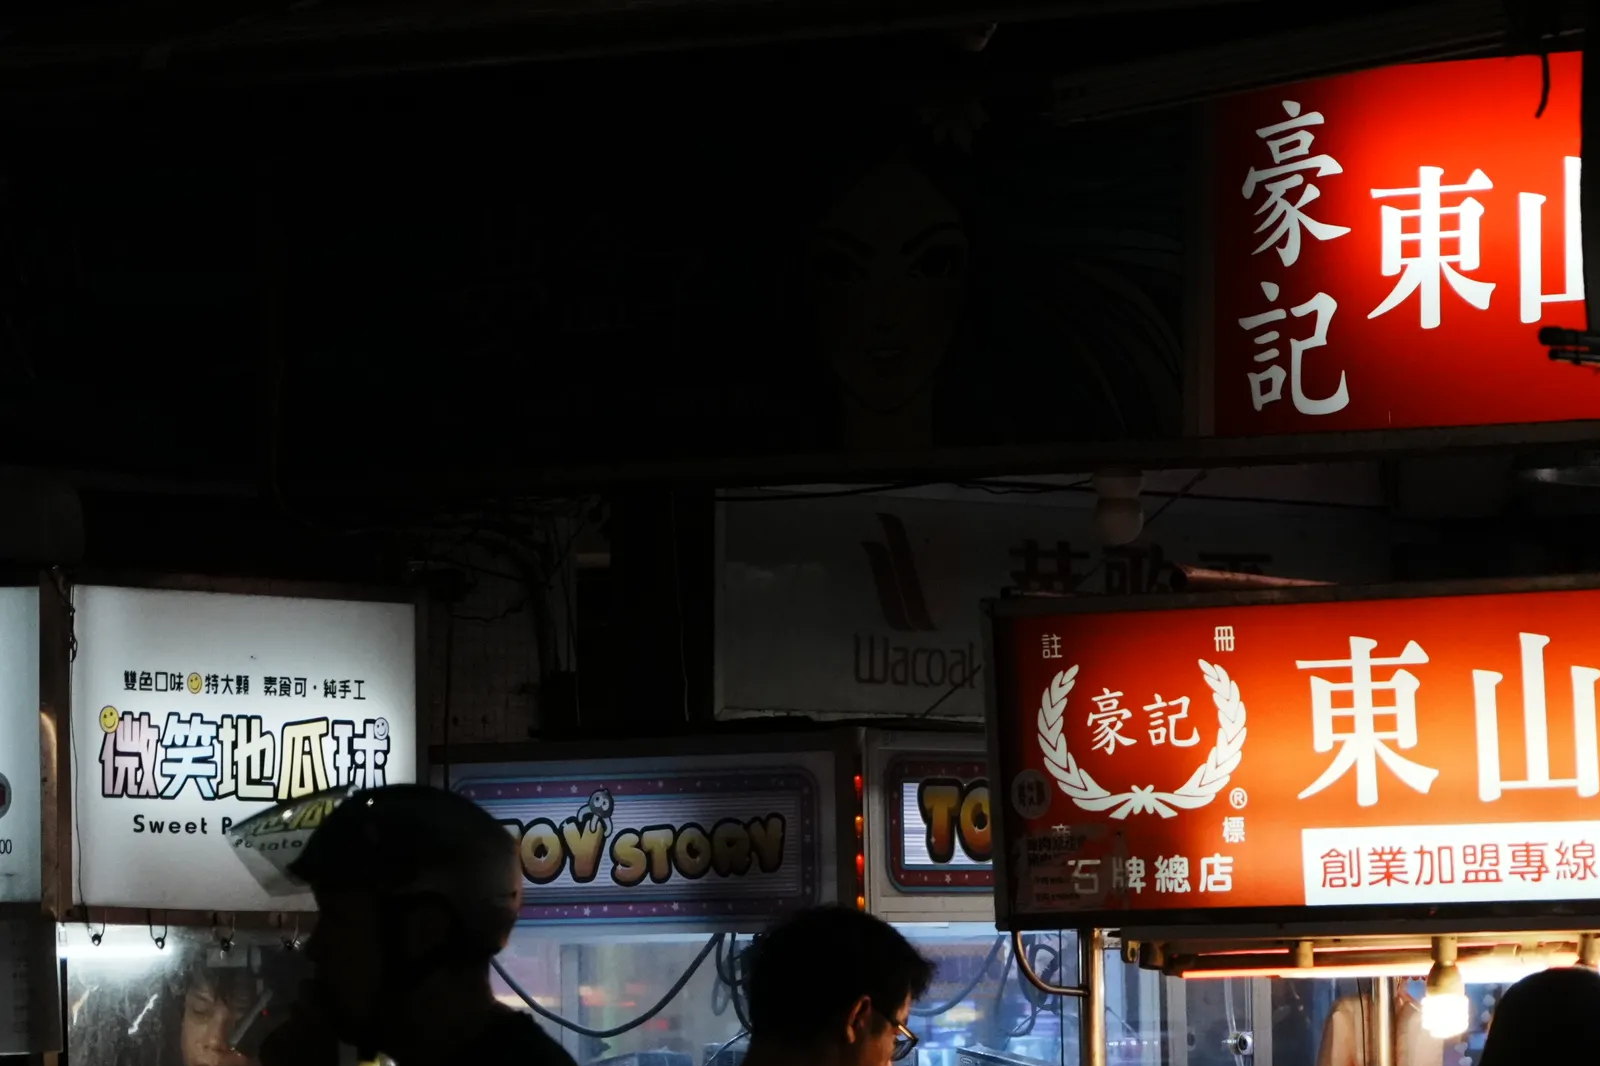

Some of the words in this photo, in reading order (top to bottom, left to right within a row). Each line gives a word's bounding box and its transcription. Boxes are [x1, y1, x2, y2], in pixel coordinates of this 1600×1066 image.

[1237, 99, 1352, 416] 豪記
[204, 673, 251, 696] 特大顆
[852, 631, 976, 689] Wacoal
[98, 710, 392, 802] 微笑地瓜球
[1086, 686, 1201, 756] 豪記
[133, 814, 208, 835] Sweet
[500, 814, 607, 885] OY
[609, 812, 786, 887] STORY
